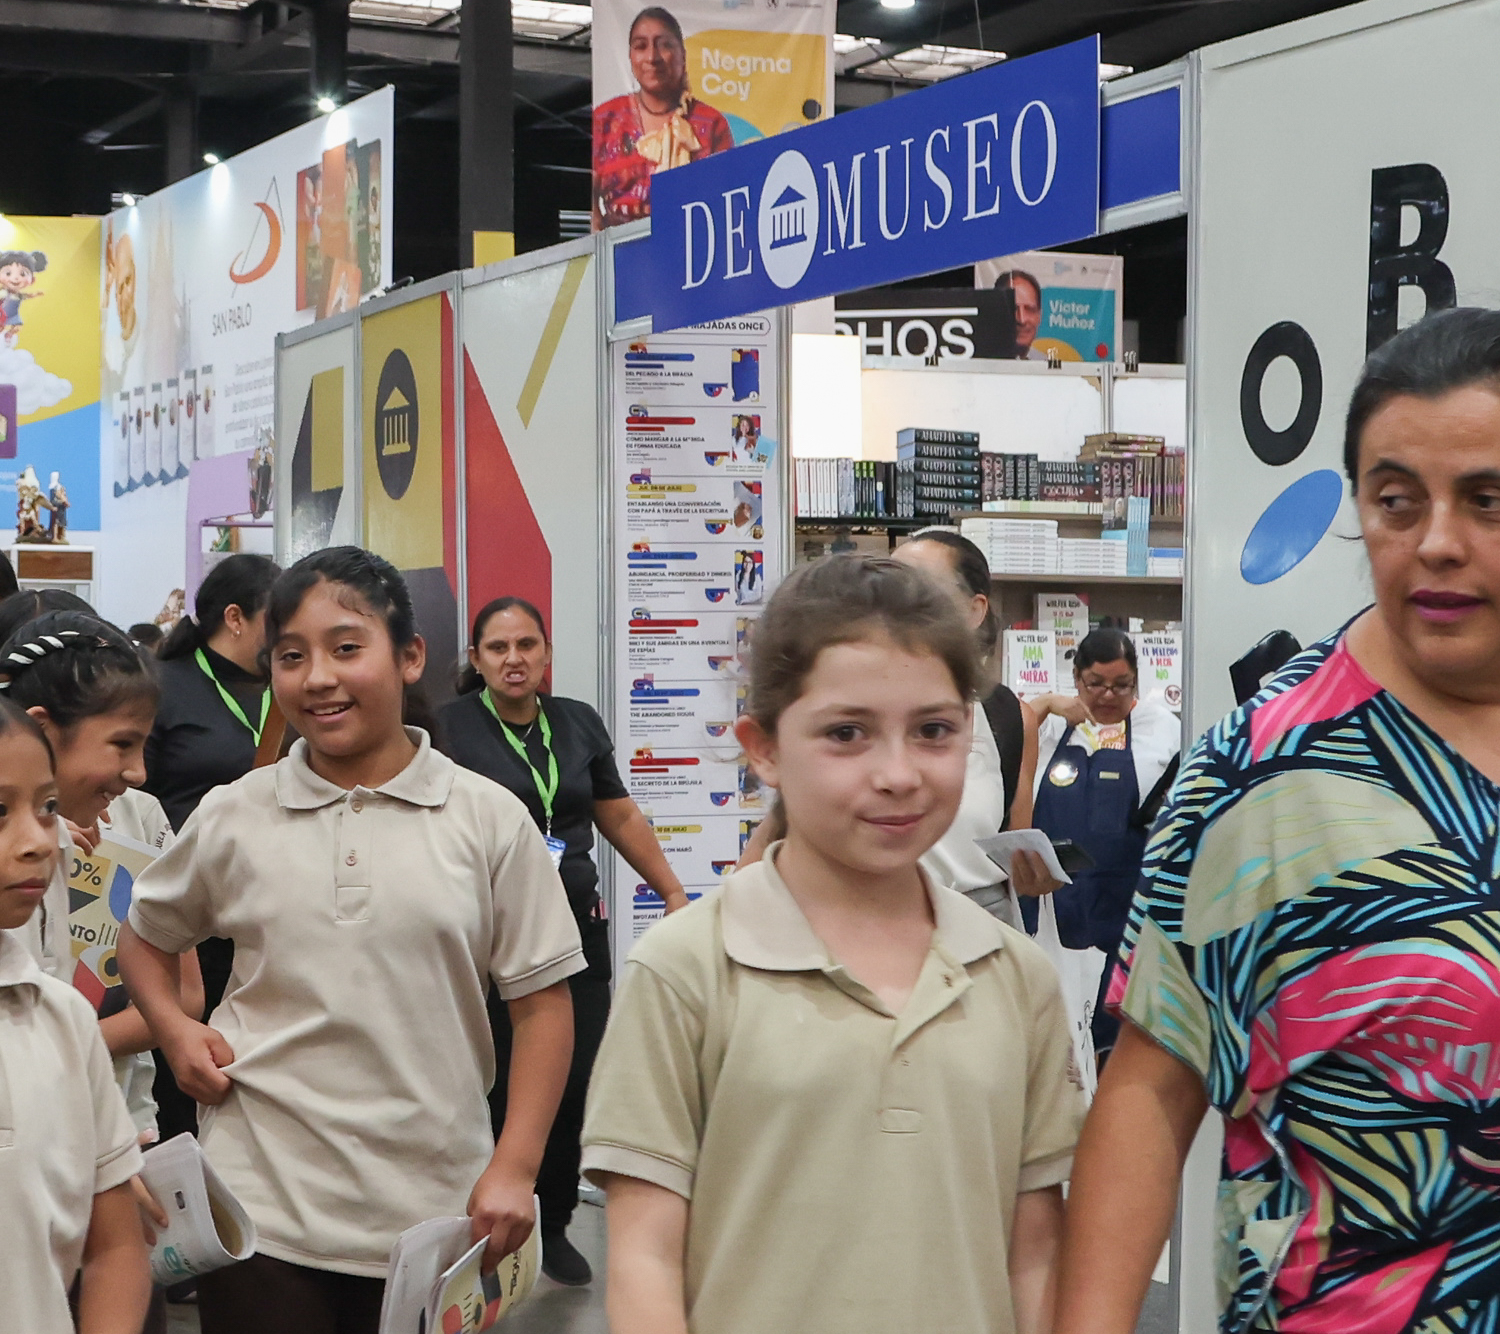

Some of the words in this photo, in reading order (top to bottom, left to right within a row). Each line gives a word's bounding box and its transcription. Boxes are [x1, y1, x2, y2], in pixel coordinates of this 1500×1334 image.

[701, 47, 792, 79] Negma
[701, 71, 752, 101] Coy
[681, 185, 753, 291] DE
[822, 100, 1058, 257] MUSEO
[212, 312, 227, 337] SAN
[738, 321, 764, 331] ONCE
[1049, 314, 1095, 330] Muñoz
[1023, 645, 1044, 660] AMA
[1152, 646, 1179, 657] DERECHO
[1156, 668, 1169, 680] NO
